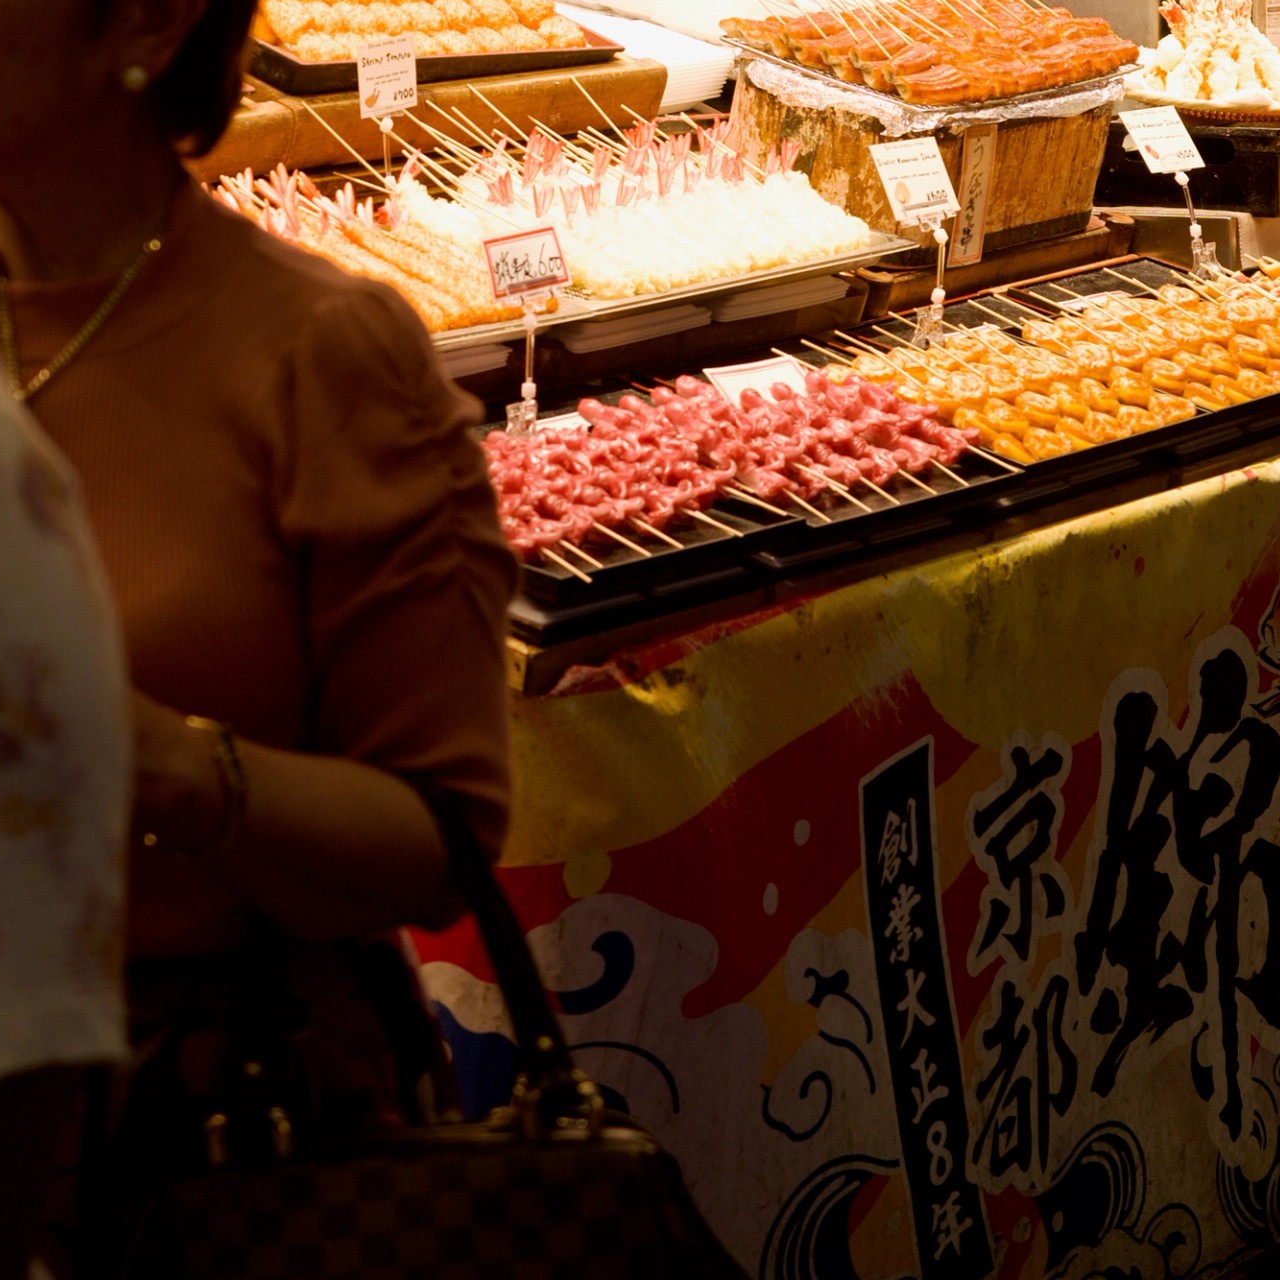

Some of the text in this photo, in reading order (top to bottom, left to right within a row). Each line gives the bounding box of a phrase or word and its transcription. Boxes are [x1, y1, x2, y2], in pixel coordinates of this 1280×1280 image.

[393, 87, 414, 101] ¥700
[876, 797, 975, 1262] 創業大正8年
[973, 746, 1077, 1178] 京都
